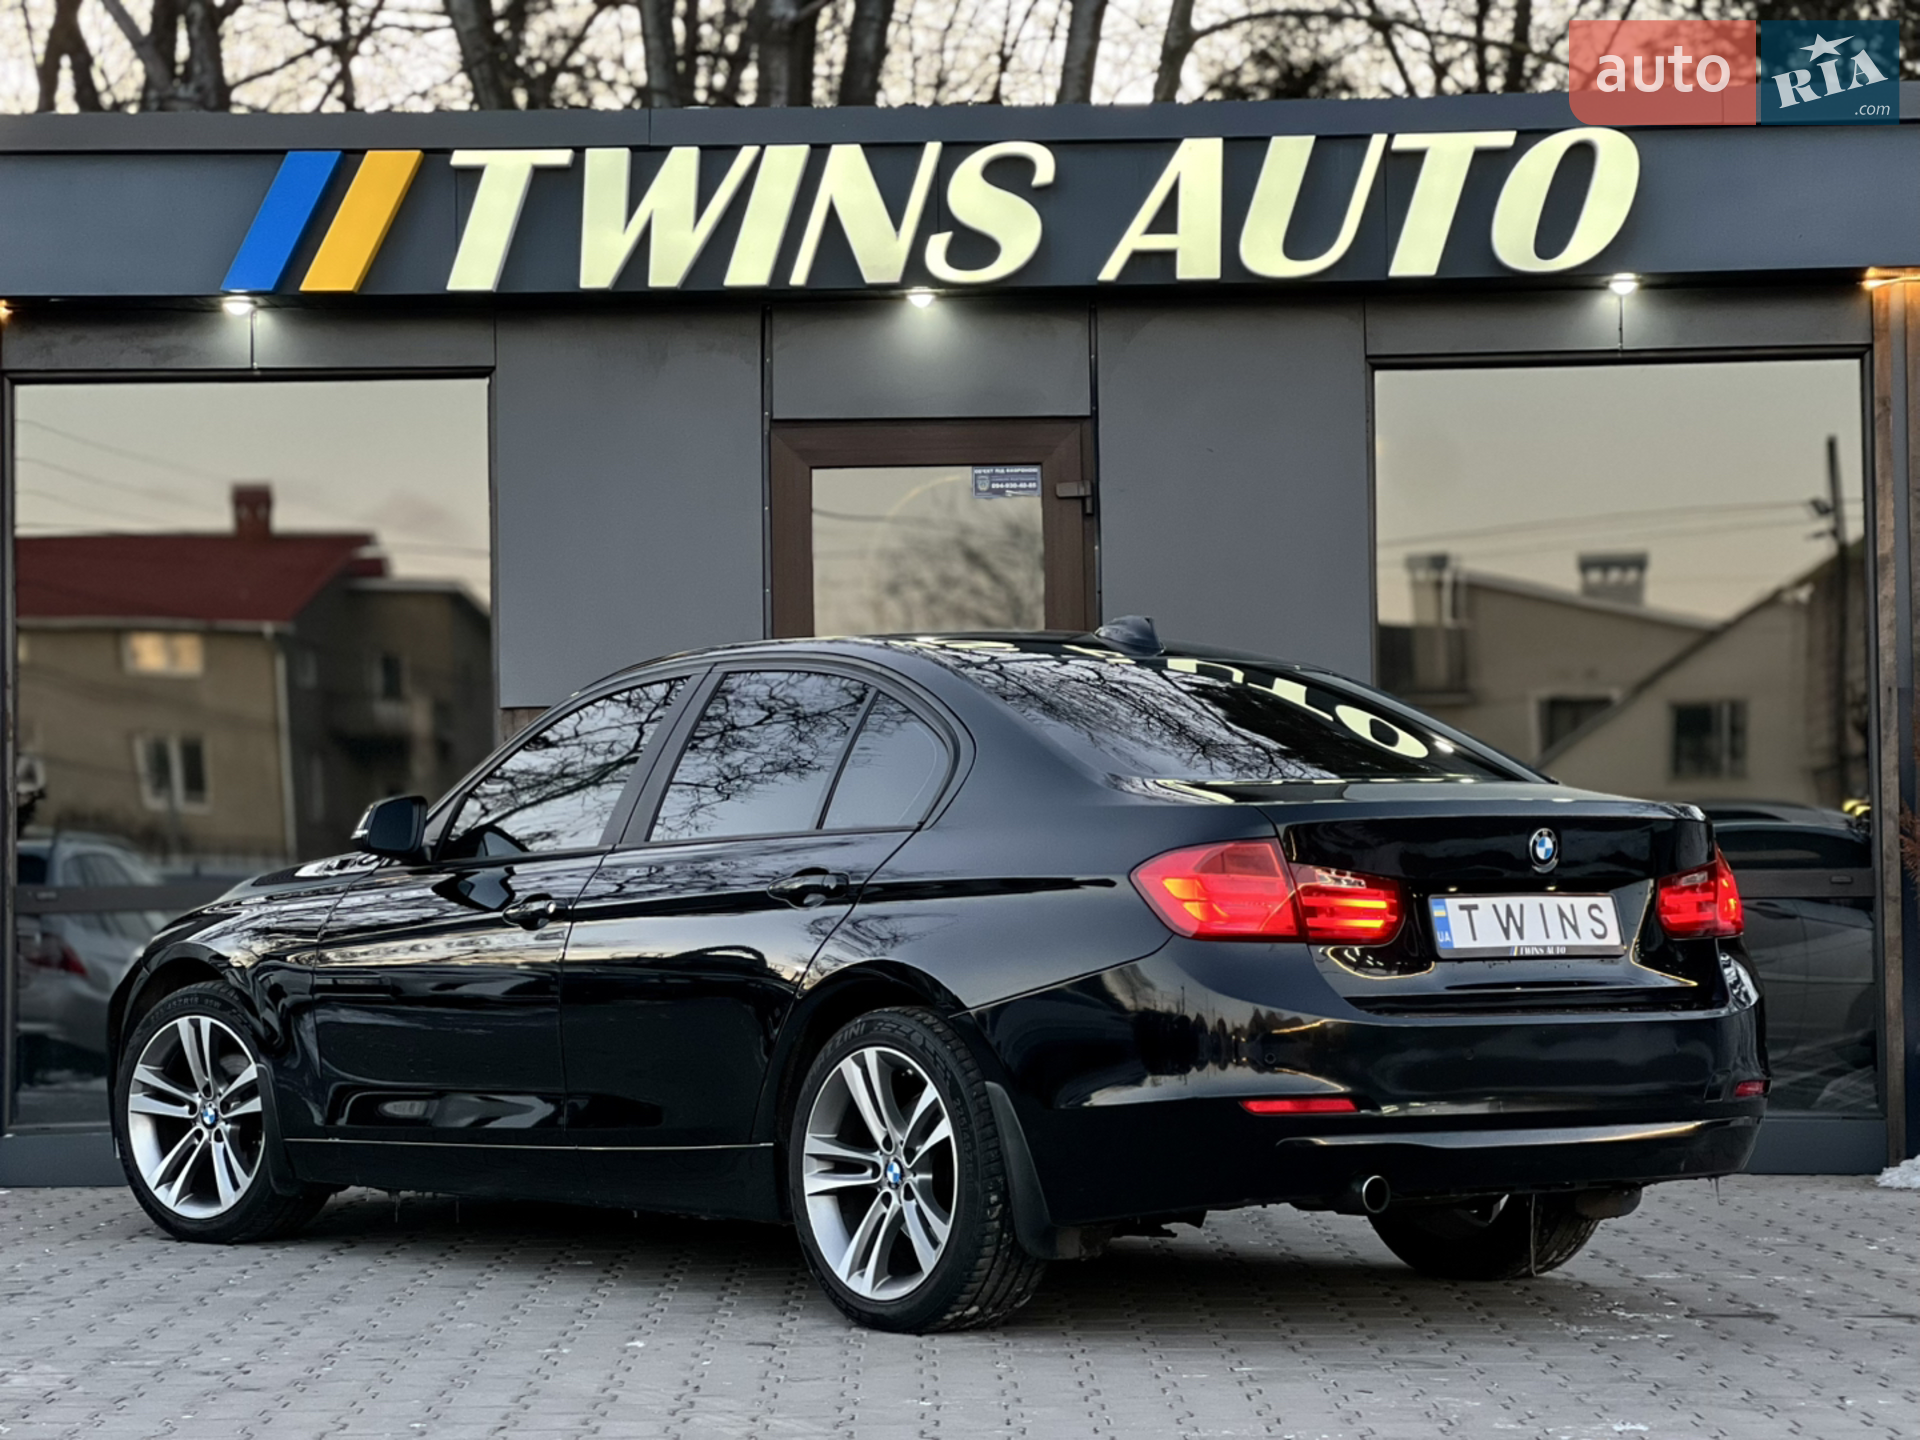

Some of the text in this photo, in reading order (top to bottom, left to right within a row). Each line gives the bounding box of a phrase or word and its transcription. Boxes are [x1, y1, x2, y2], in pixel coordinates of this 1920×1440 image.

[446, 126, 1641, 291] TWINS AUTO
[1458, 903, 1608, 941] TWINS
[1437, 931, 1451, 943] UA
[1520, 945, 1567, 956] TWINS AUTO
